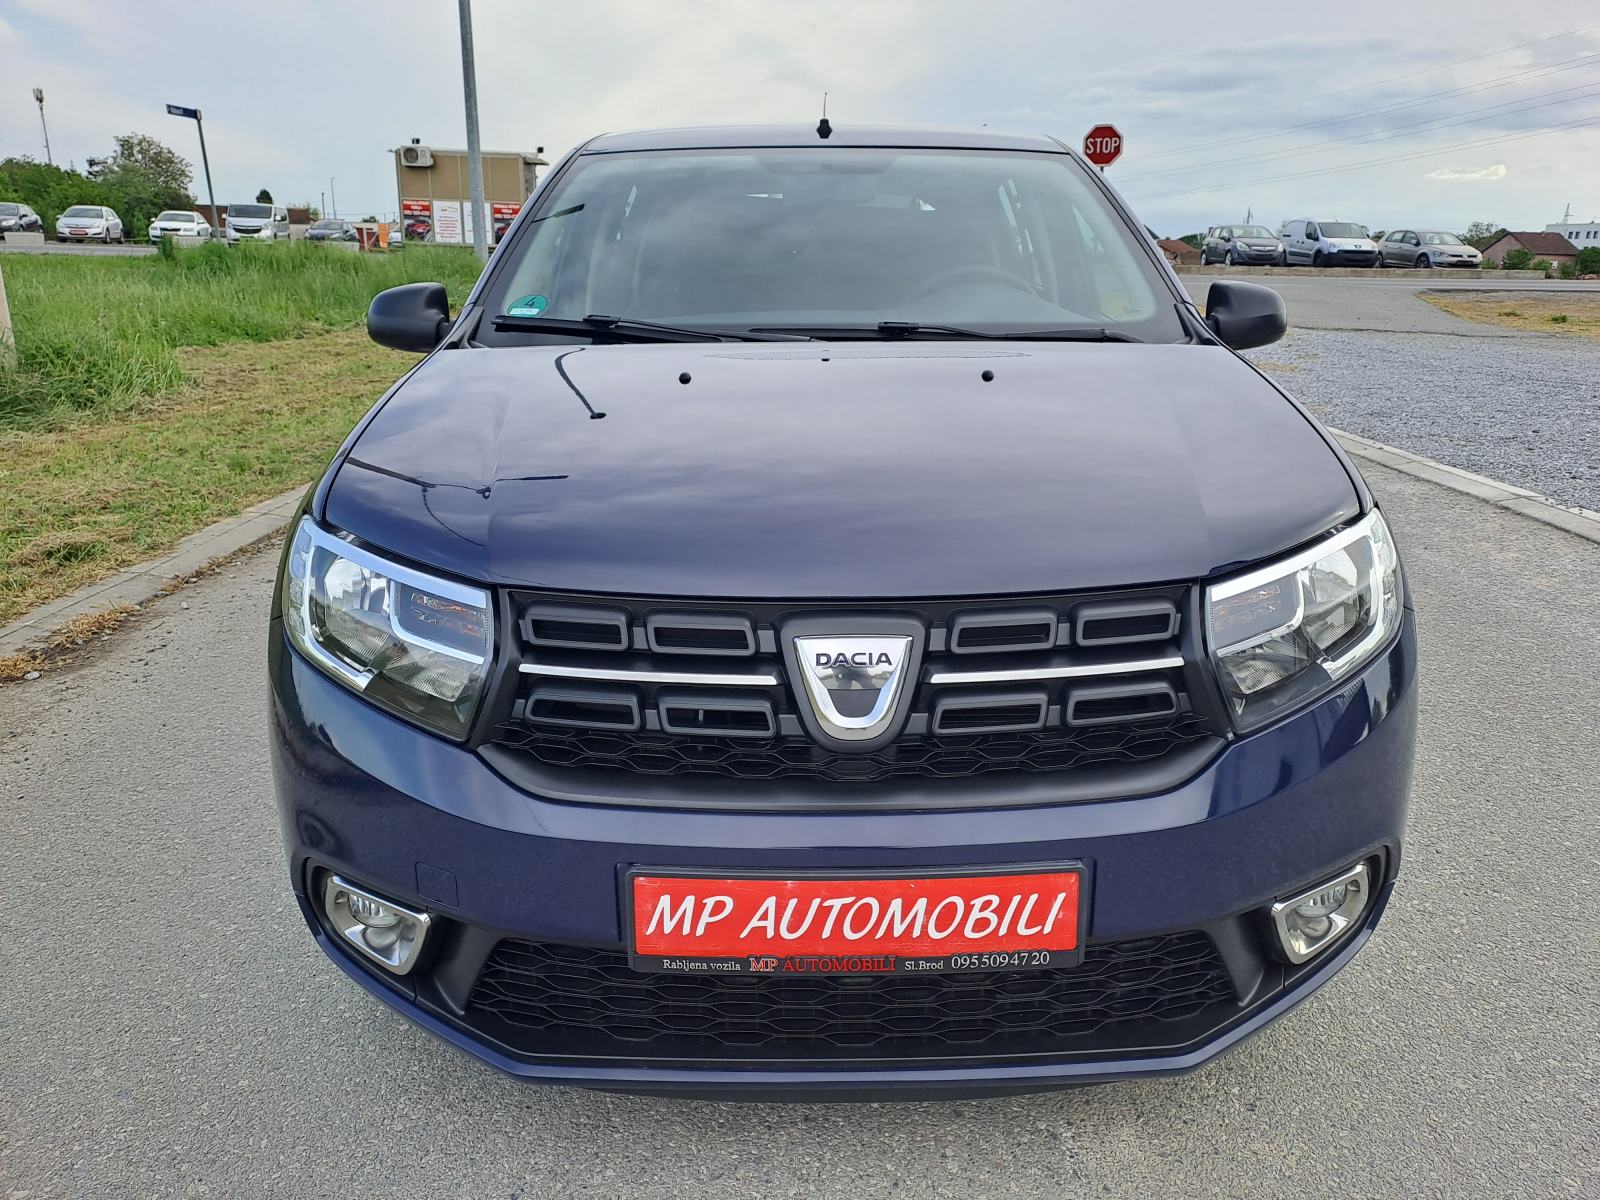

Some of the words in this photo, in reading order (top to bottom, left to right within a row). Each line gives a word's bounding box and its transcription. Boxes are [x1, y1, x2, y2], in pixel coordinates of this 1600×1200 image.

[1086, 137, 1120, 154] STOP
[524, 296, 537, 308] 4
[815, 652, 893, 667] DACIA
[645, 894, 734, 937] MP
[739, 892, 1067, 940] AUTOMOBILI
[662, 959, 708, 972] Rabljena
[710, 961, 742, 971] vozila
[749, 957, 779, 972] MP
[783, 957, 897, 972] AUTOMOBILI
